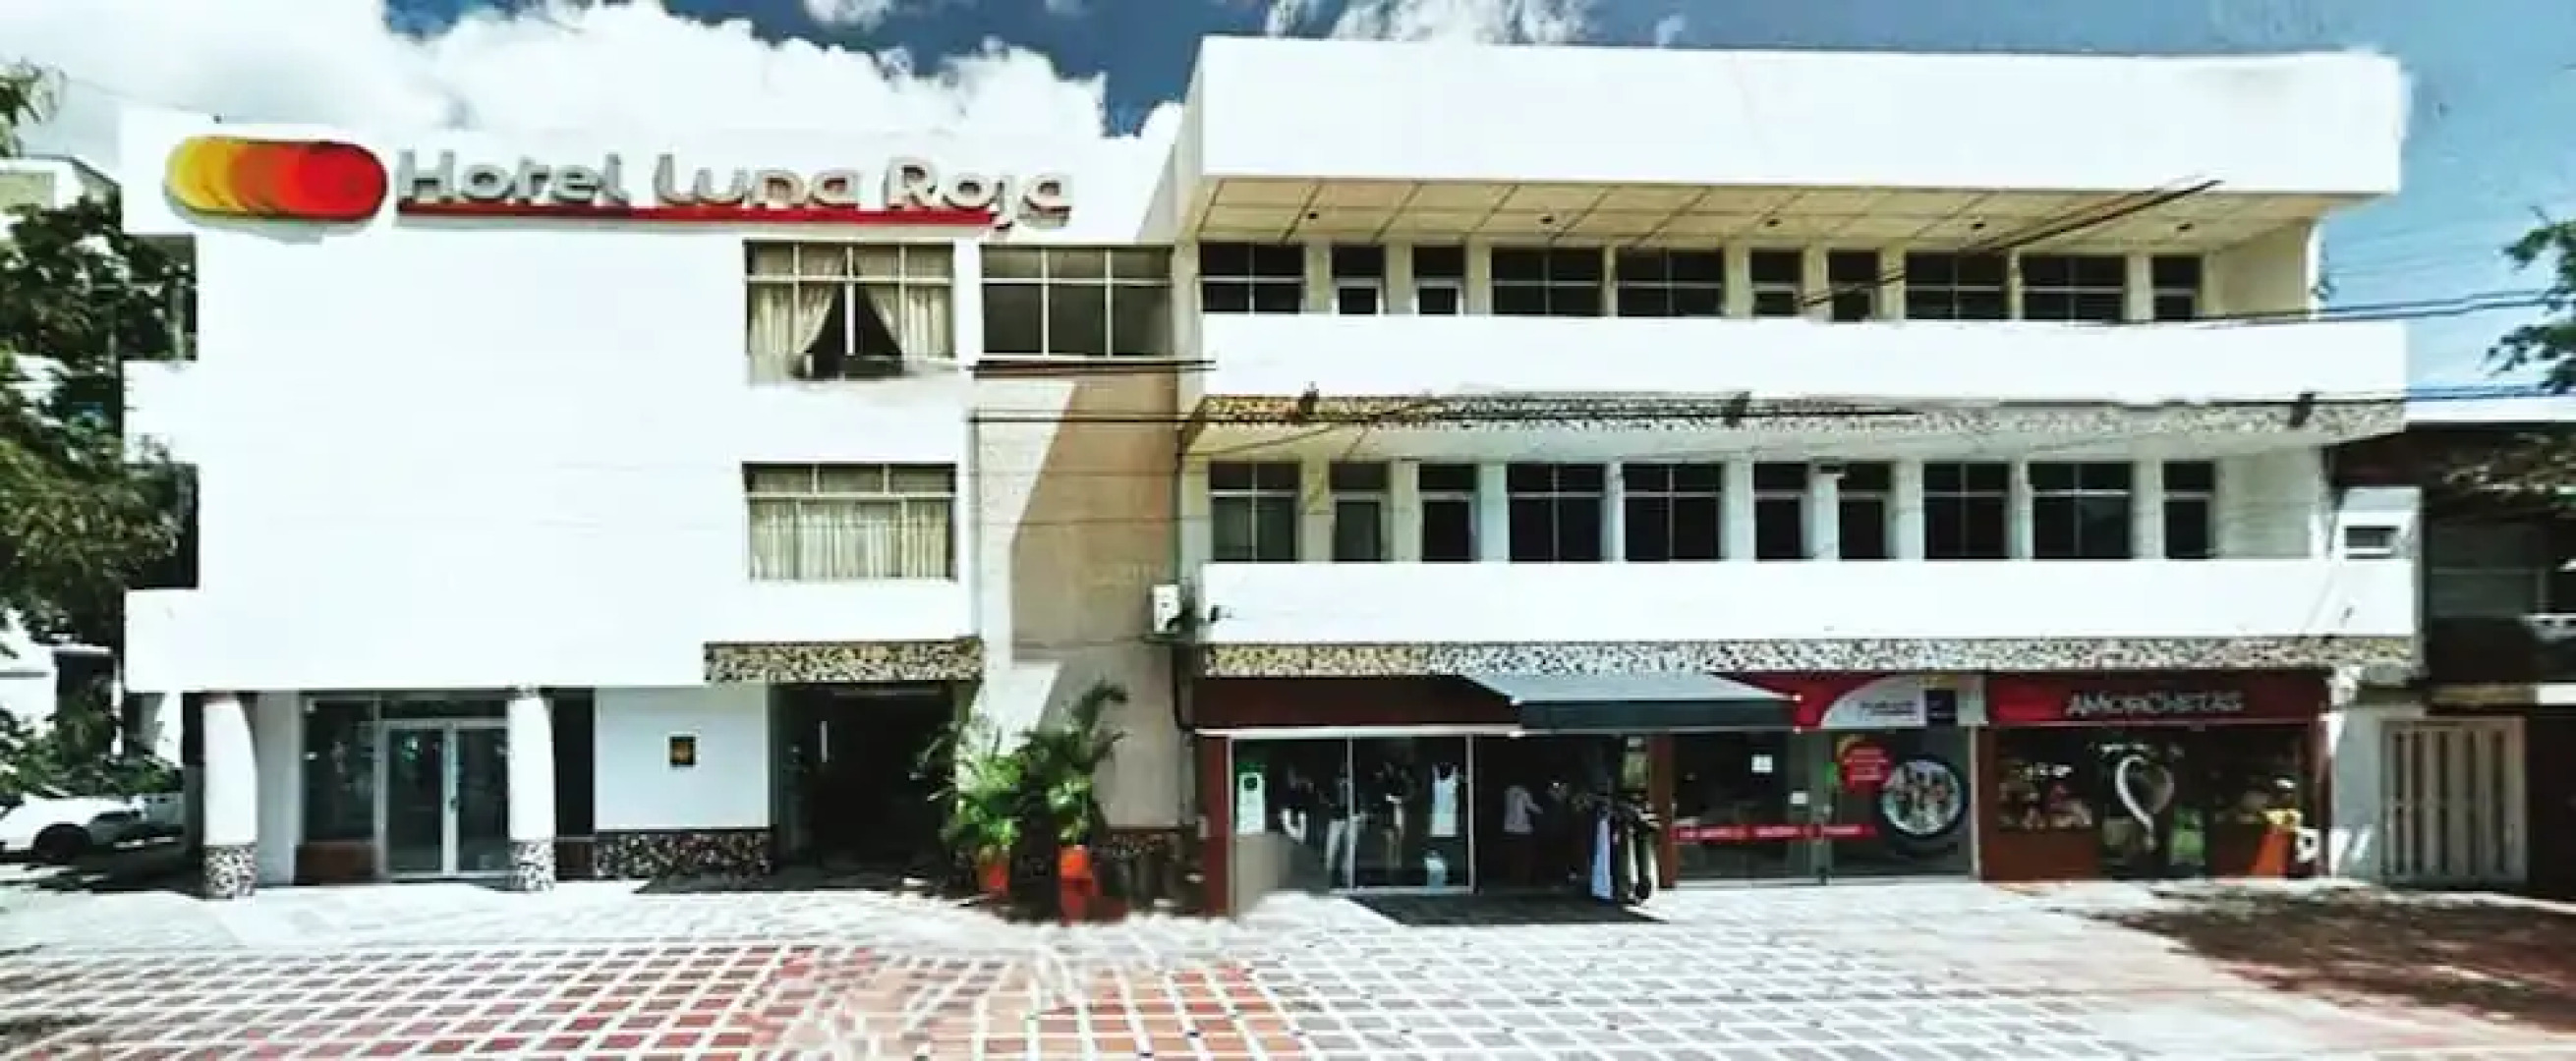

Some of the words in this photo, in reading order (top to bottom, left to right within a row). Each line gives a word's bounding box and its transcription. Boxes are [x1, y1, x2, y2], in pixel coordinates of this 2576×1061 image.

[395, 147, 630, 205] Hotel
[652, 152, 861, 206] Luna
[884, 155, 1072, 230] Roja
